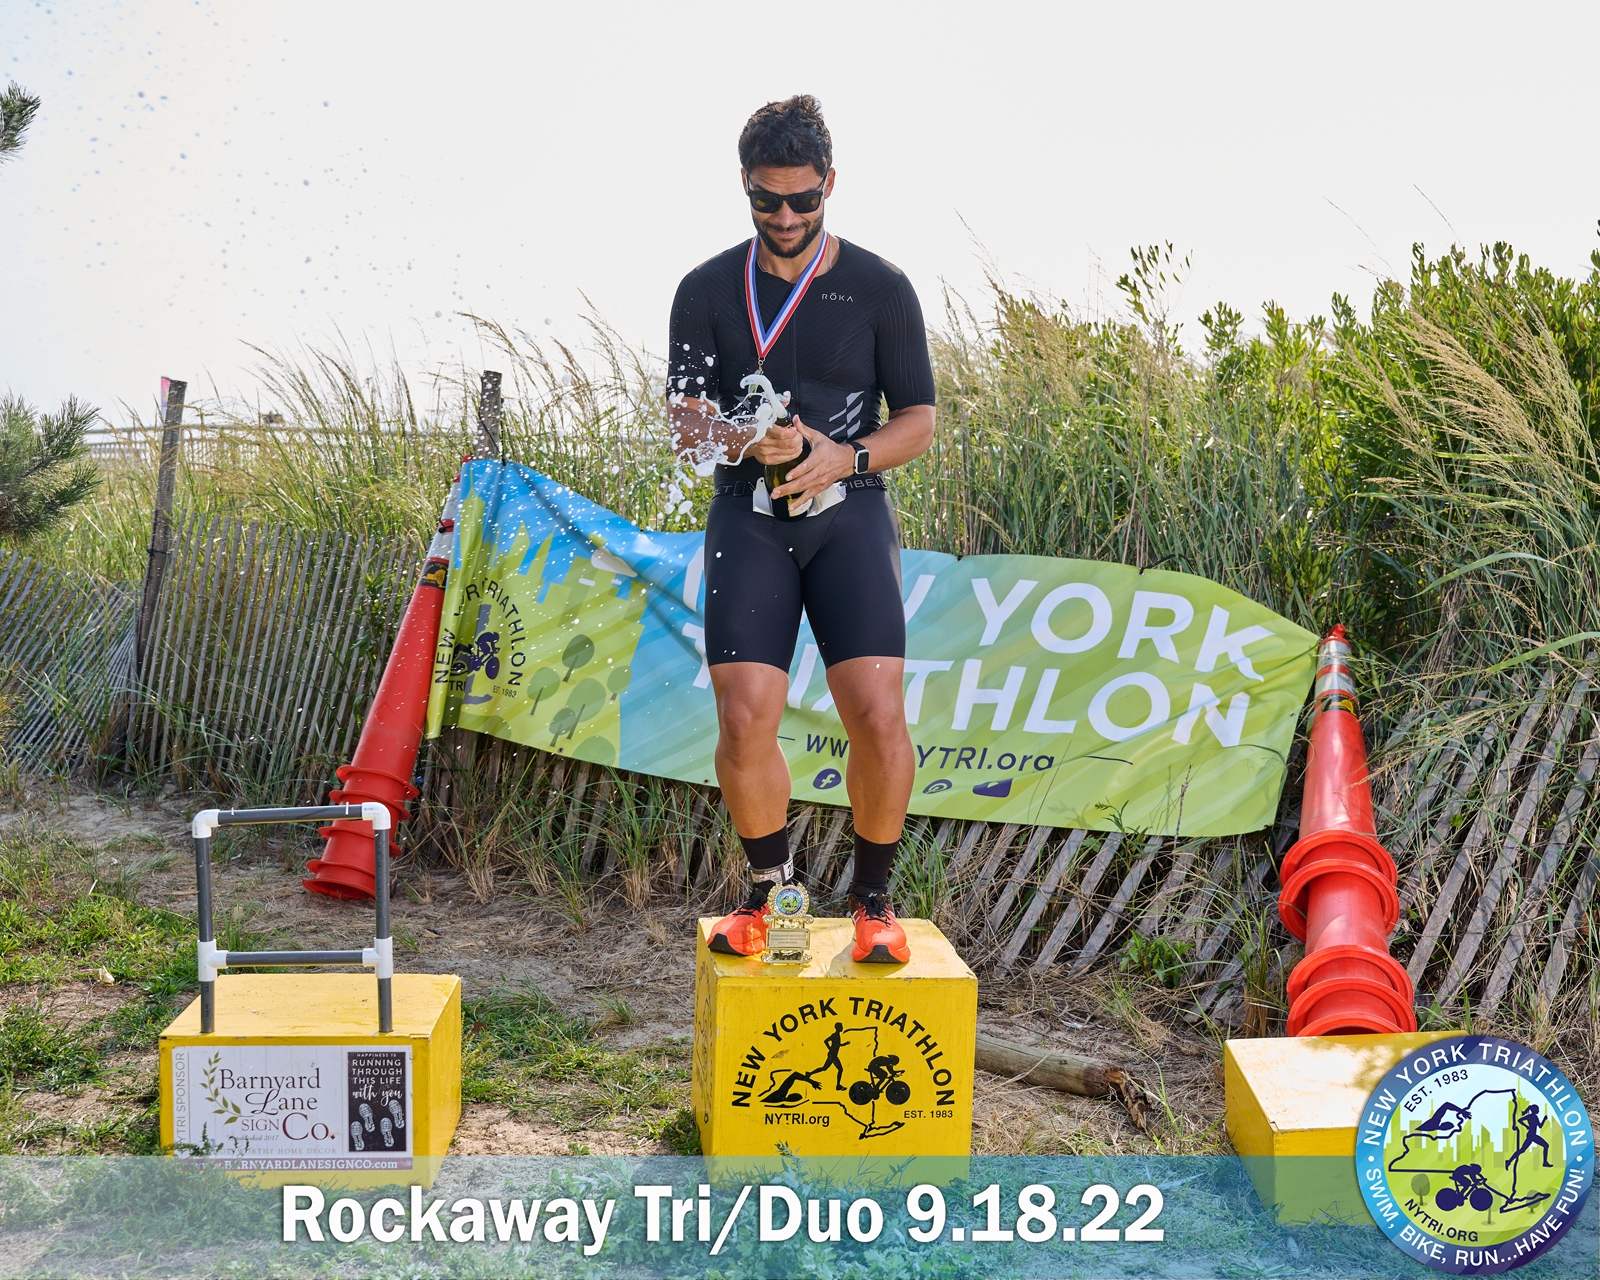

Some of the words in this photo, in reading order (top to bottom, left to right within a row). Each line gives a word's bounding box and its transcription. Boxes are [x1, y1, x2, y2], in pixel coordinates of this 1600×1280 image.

[971, 578, 1275, 682] YORK
[434, 628, 456, 684] NEW
[352, 1059, 401, 1067] RUNNING
[731, 1045, 766, 1108] NEW
[763, 997, 838, 1043] YORK
[849, 996, 955, 1106] TRIATHLON
[175, 1052, 186, 1112] SPONSOR
[219, 1067, 321, 1092] Barnyard
[245, 1088, 318, 1116] Lane
[352, 1084, 378, 1101] with
[381, 1089, 403, 1106] you
[241, 1118, 280, 1131] SIGN
[282, 1112, 335, 1141] Co.
[764, 1112, 830, 1128] NYTRI.org
[903, 1110, 926, 1119] EST.
[930, 1110, 953, 1119] 1983
